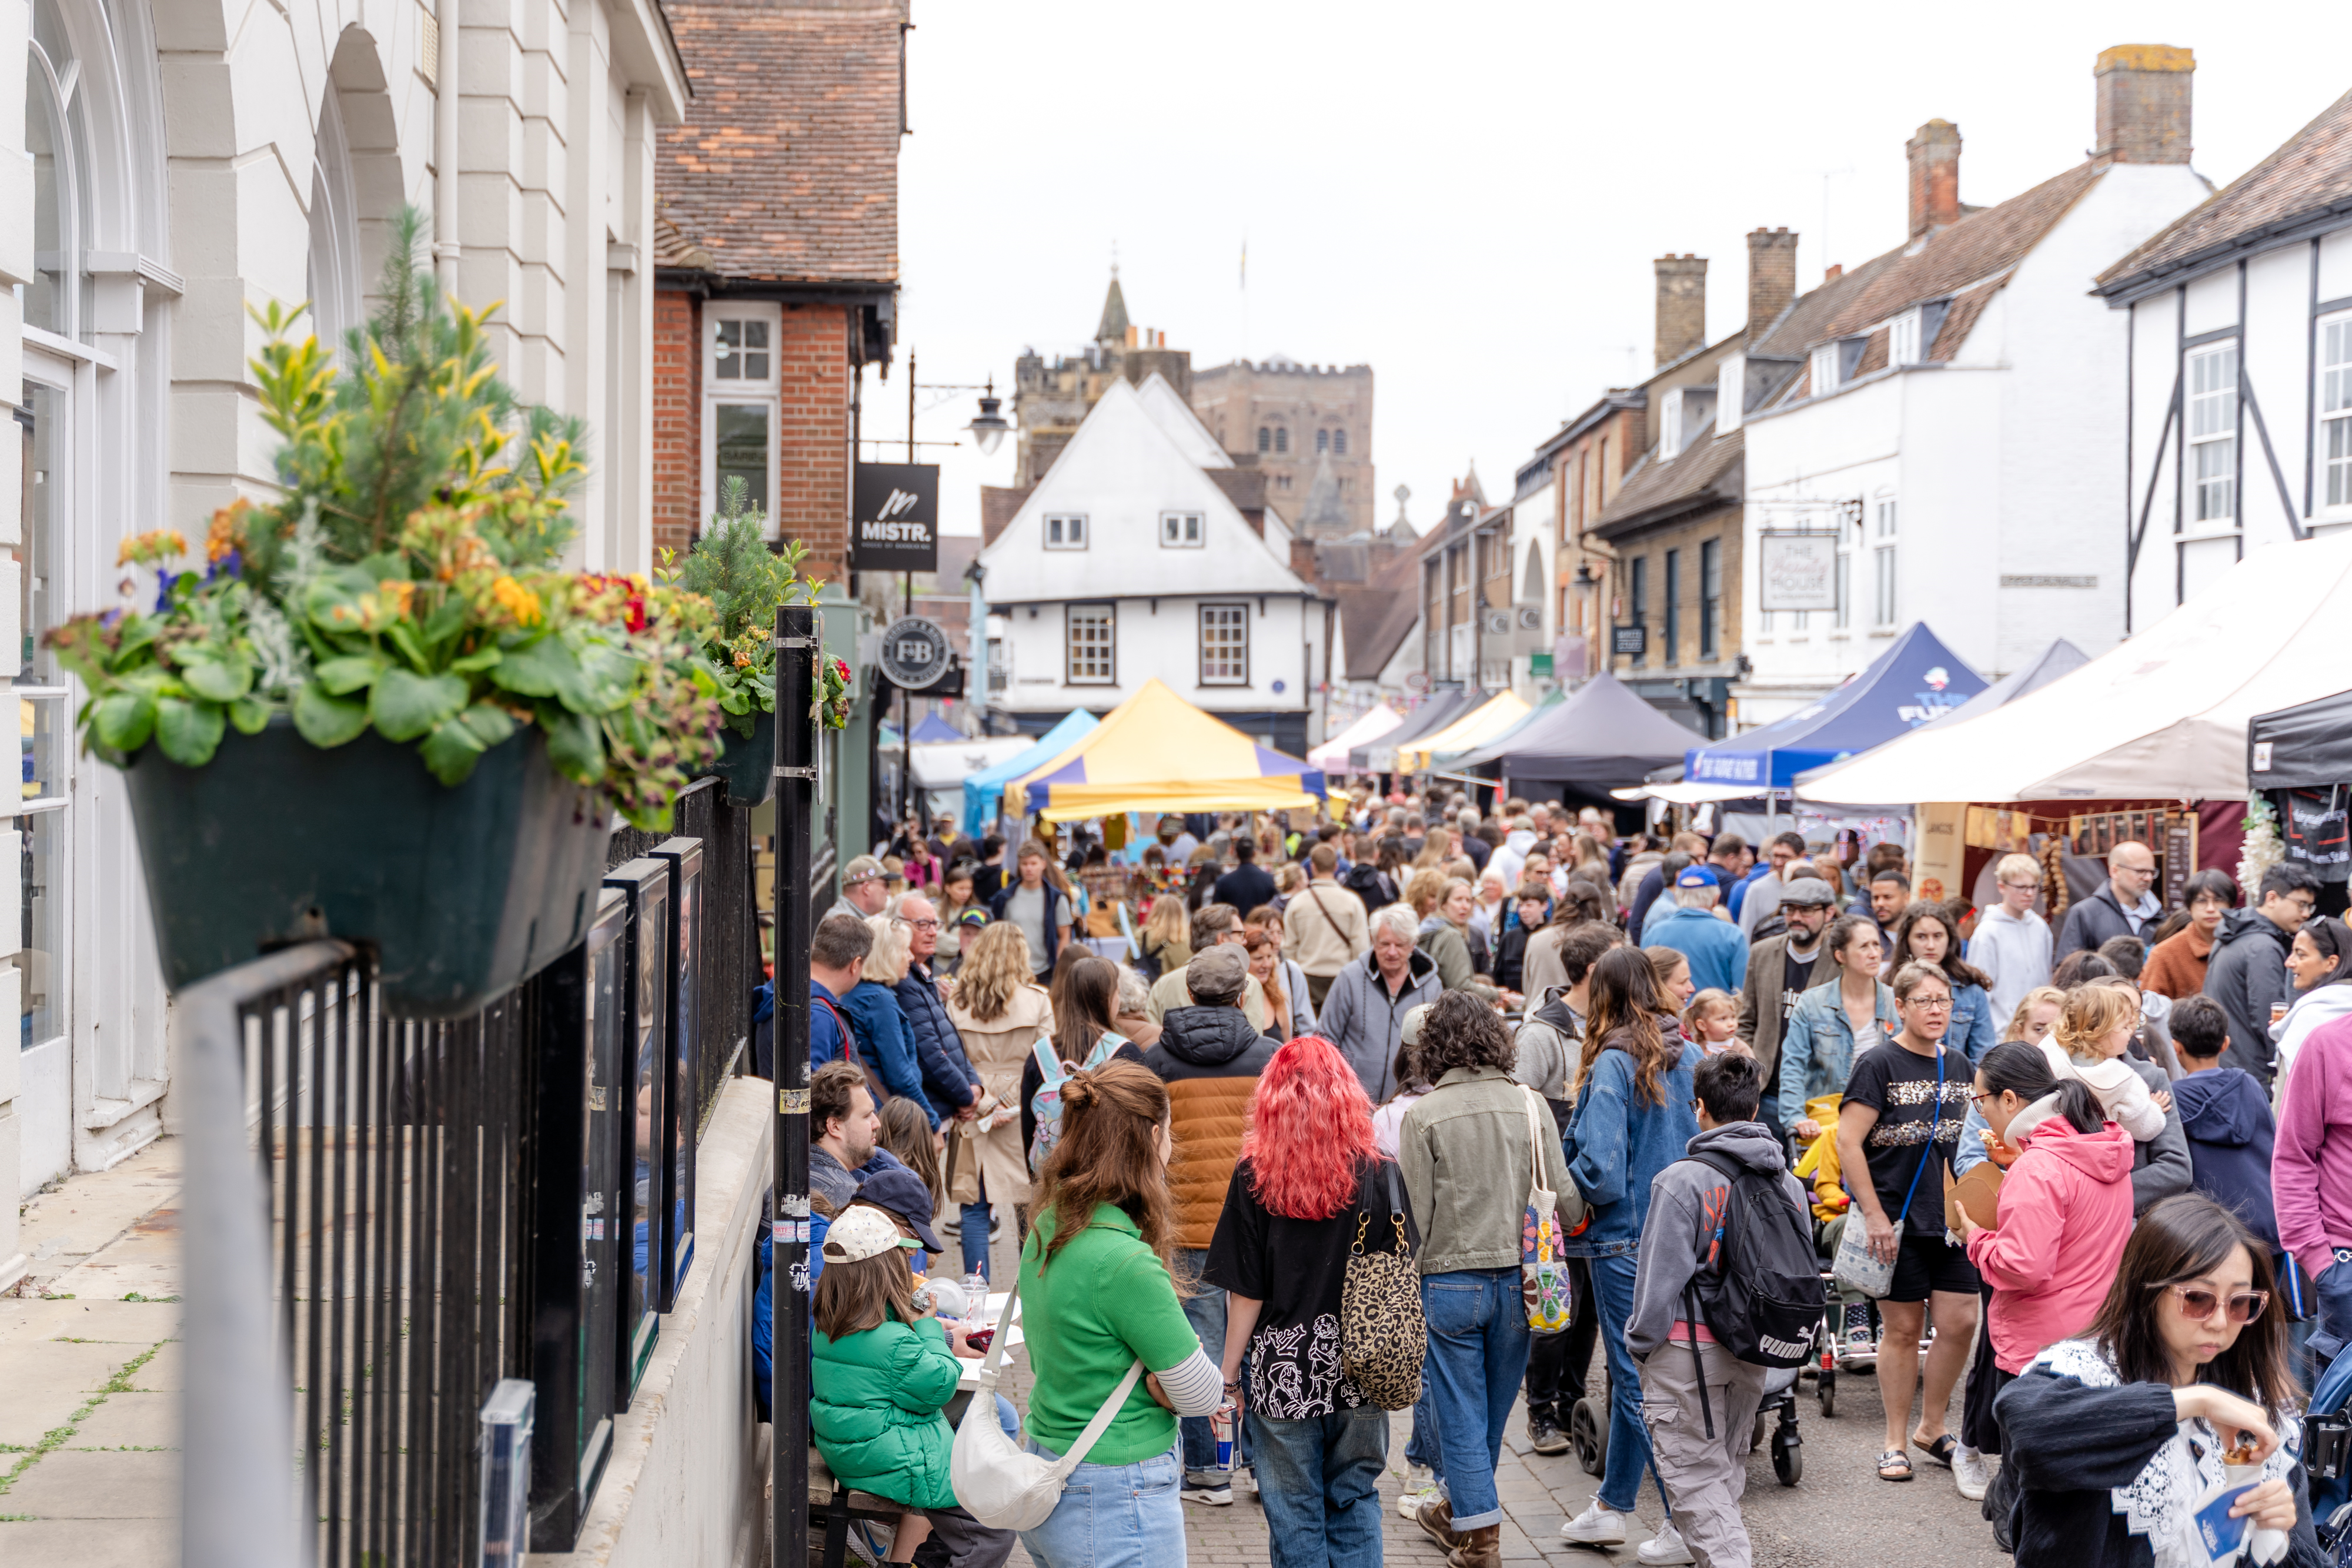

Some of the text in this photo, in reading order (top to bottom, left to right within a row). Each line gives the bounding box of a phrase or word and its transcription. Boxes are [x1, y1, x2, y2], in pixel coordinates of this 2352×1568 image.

[861, 521, 931, 542] MISTR.
[1785, 544, 1813, 559] THE
[1770, 576, 1826, 591] HOUSE
[896, 640, 933, 664] F&B
[1759, 1334, 1809, 1359] PUMA
